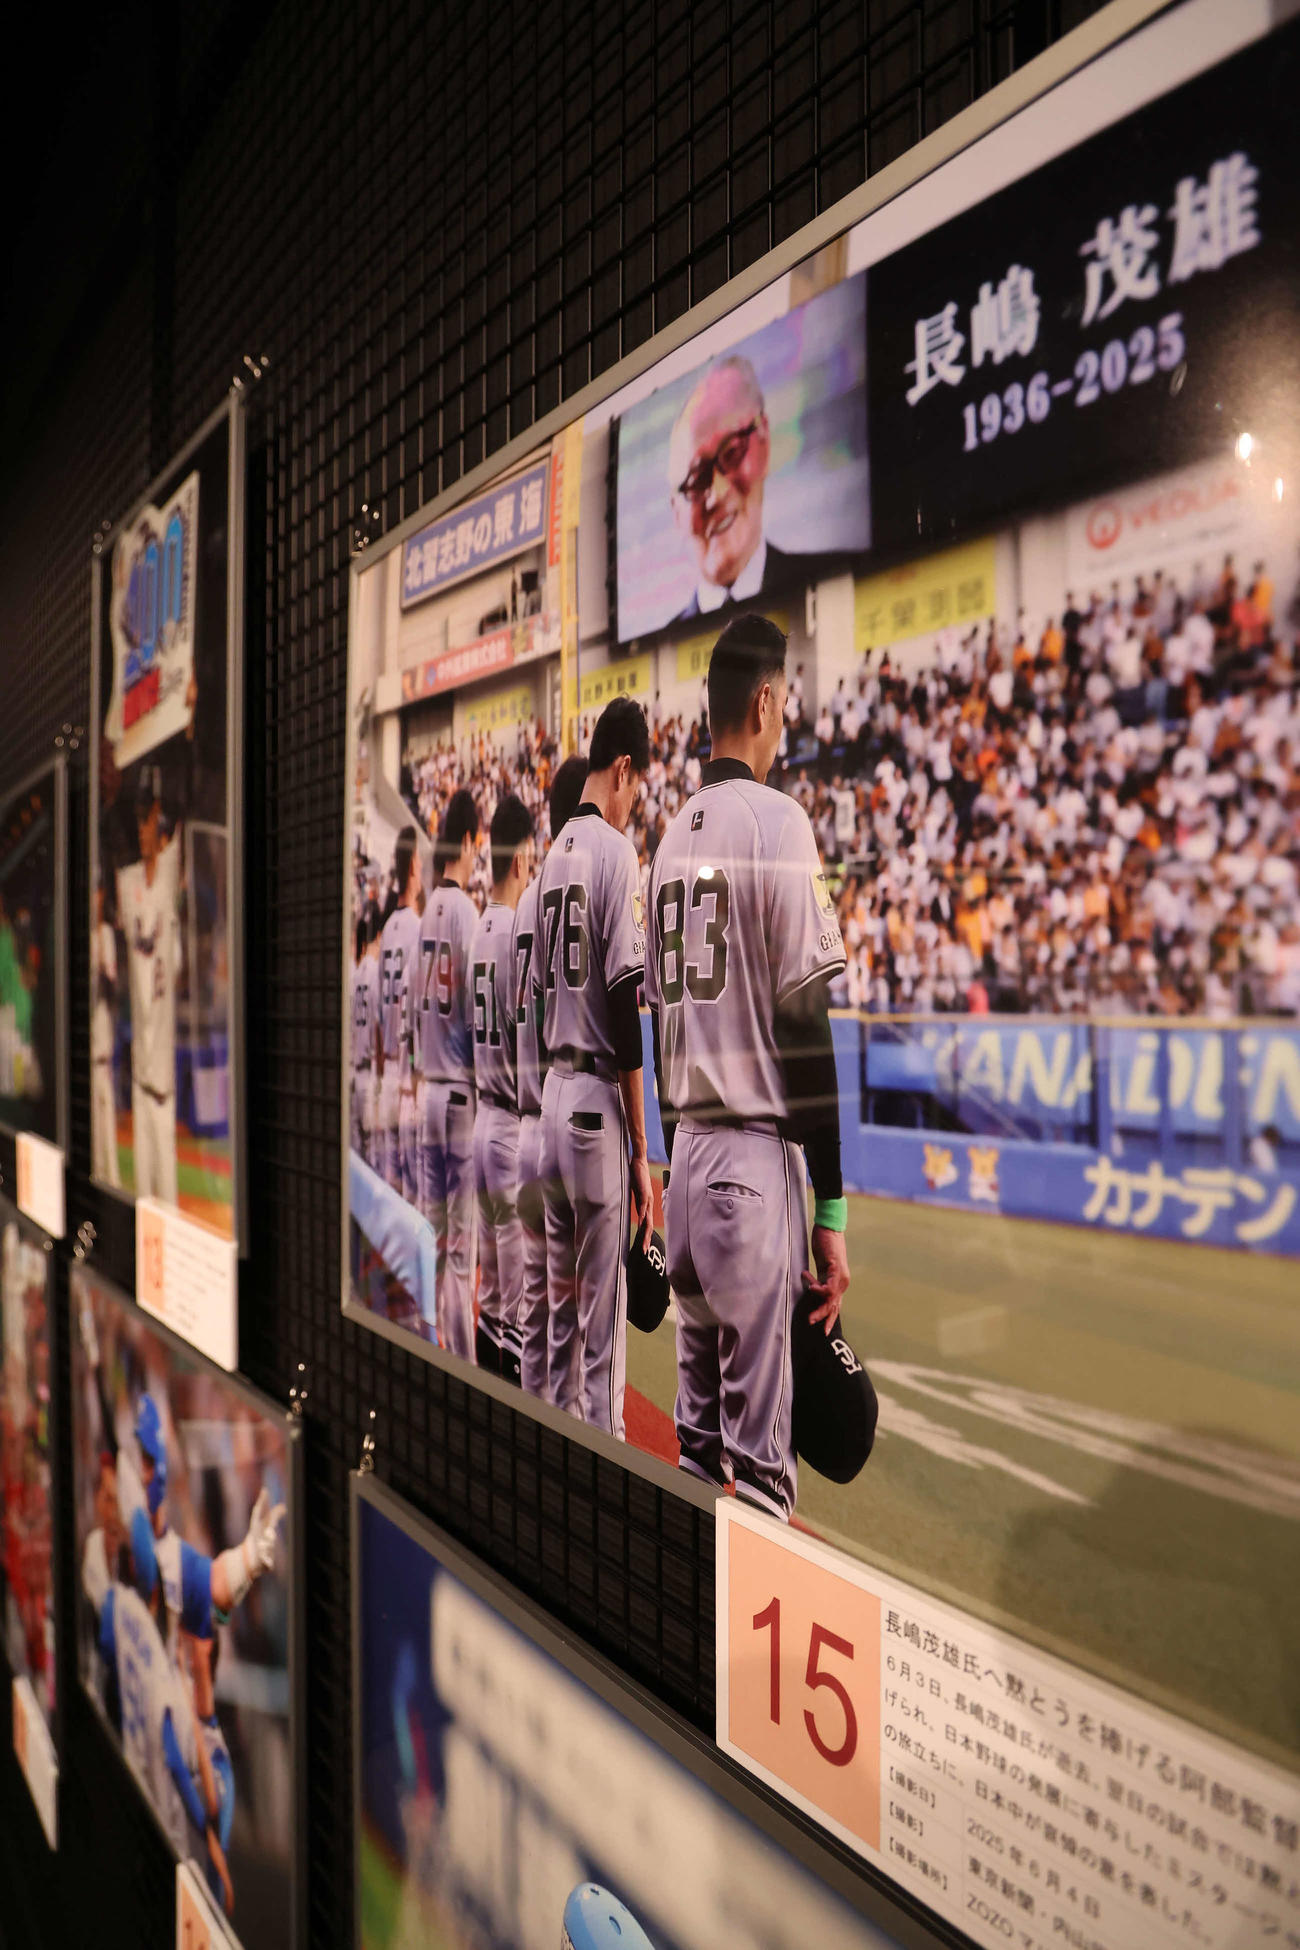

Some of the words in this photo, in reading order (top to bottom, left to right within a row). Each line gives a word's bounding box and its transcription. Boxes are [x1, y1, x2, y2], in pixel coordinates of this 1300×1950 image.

[904, 263, 1041, 407] 長嶋
[1078, 152, 1262, 329] 茂雄
[963, 311, 1186, 452] 1936-2025
[421, 938, 452, 1018] 79
[542, 883, 590, 992] 76
[656, 866, 730, 1006] 83
[473, 961, 501, 1049] 51
[1082, 1155, 1296, 1243] カナデン
[753, 1597, 858, 1767] 15
